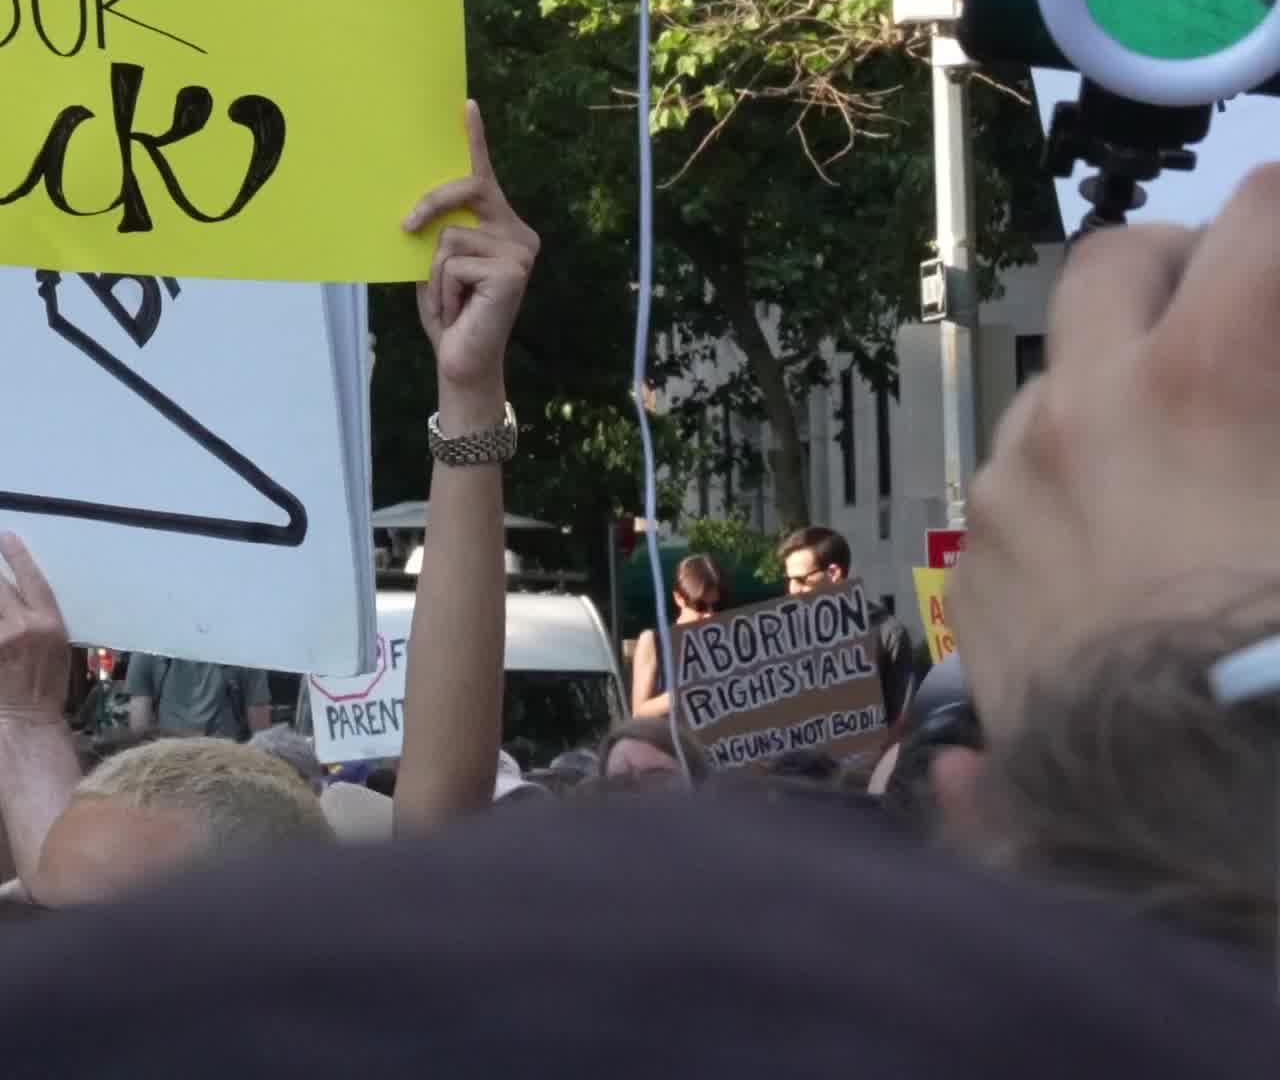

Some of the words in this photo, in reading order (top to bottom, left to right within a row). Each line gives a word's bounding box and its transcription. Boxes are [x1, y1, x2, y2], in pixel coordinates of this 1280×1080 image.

[682, 588, 866, 681] ABORTION
[686, 665, 795, 724] RIGHTS
[790, 718, 825, 748] NOT
